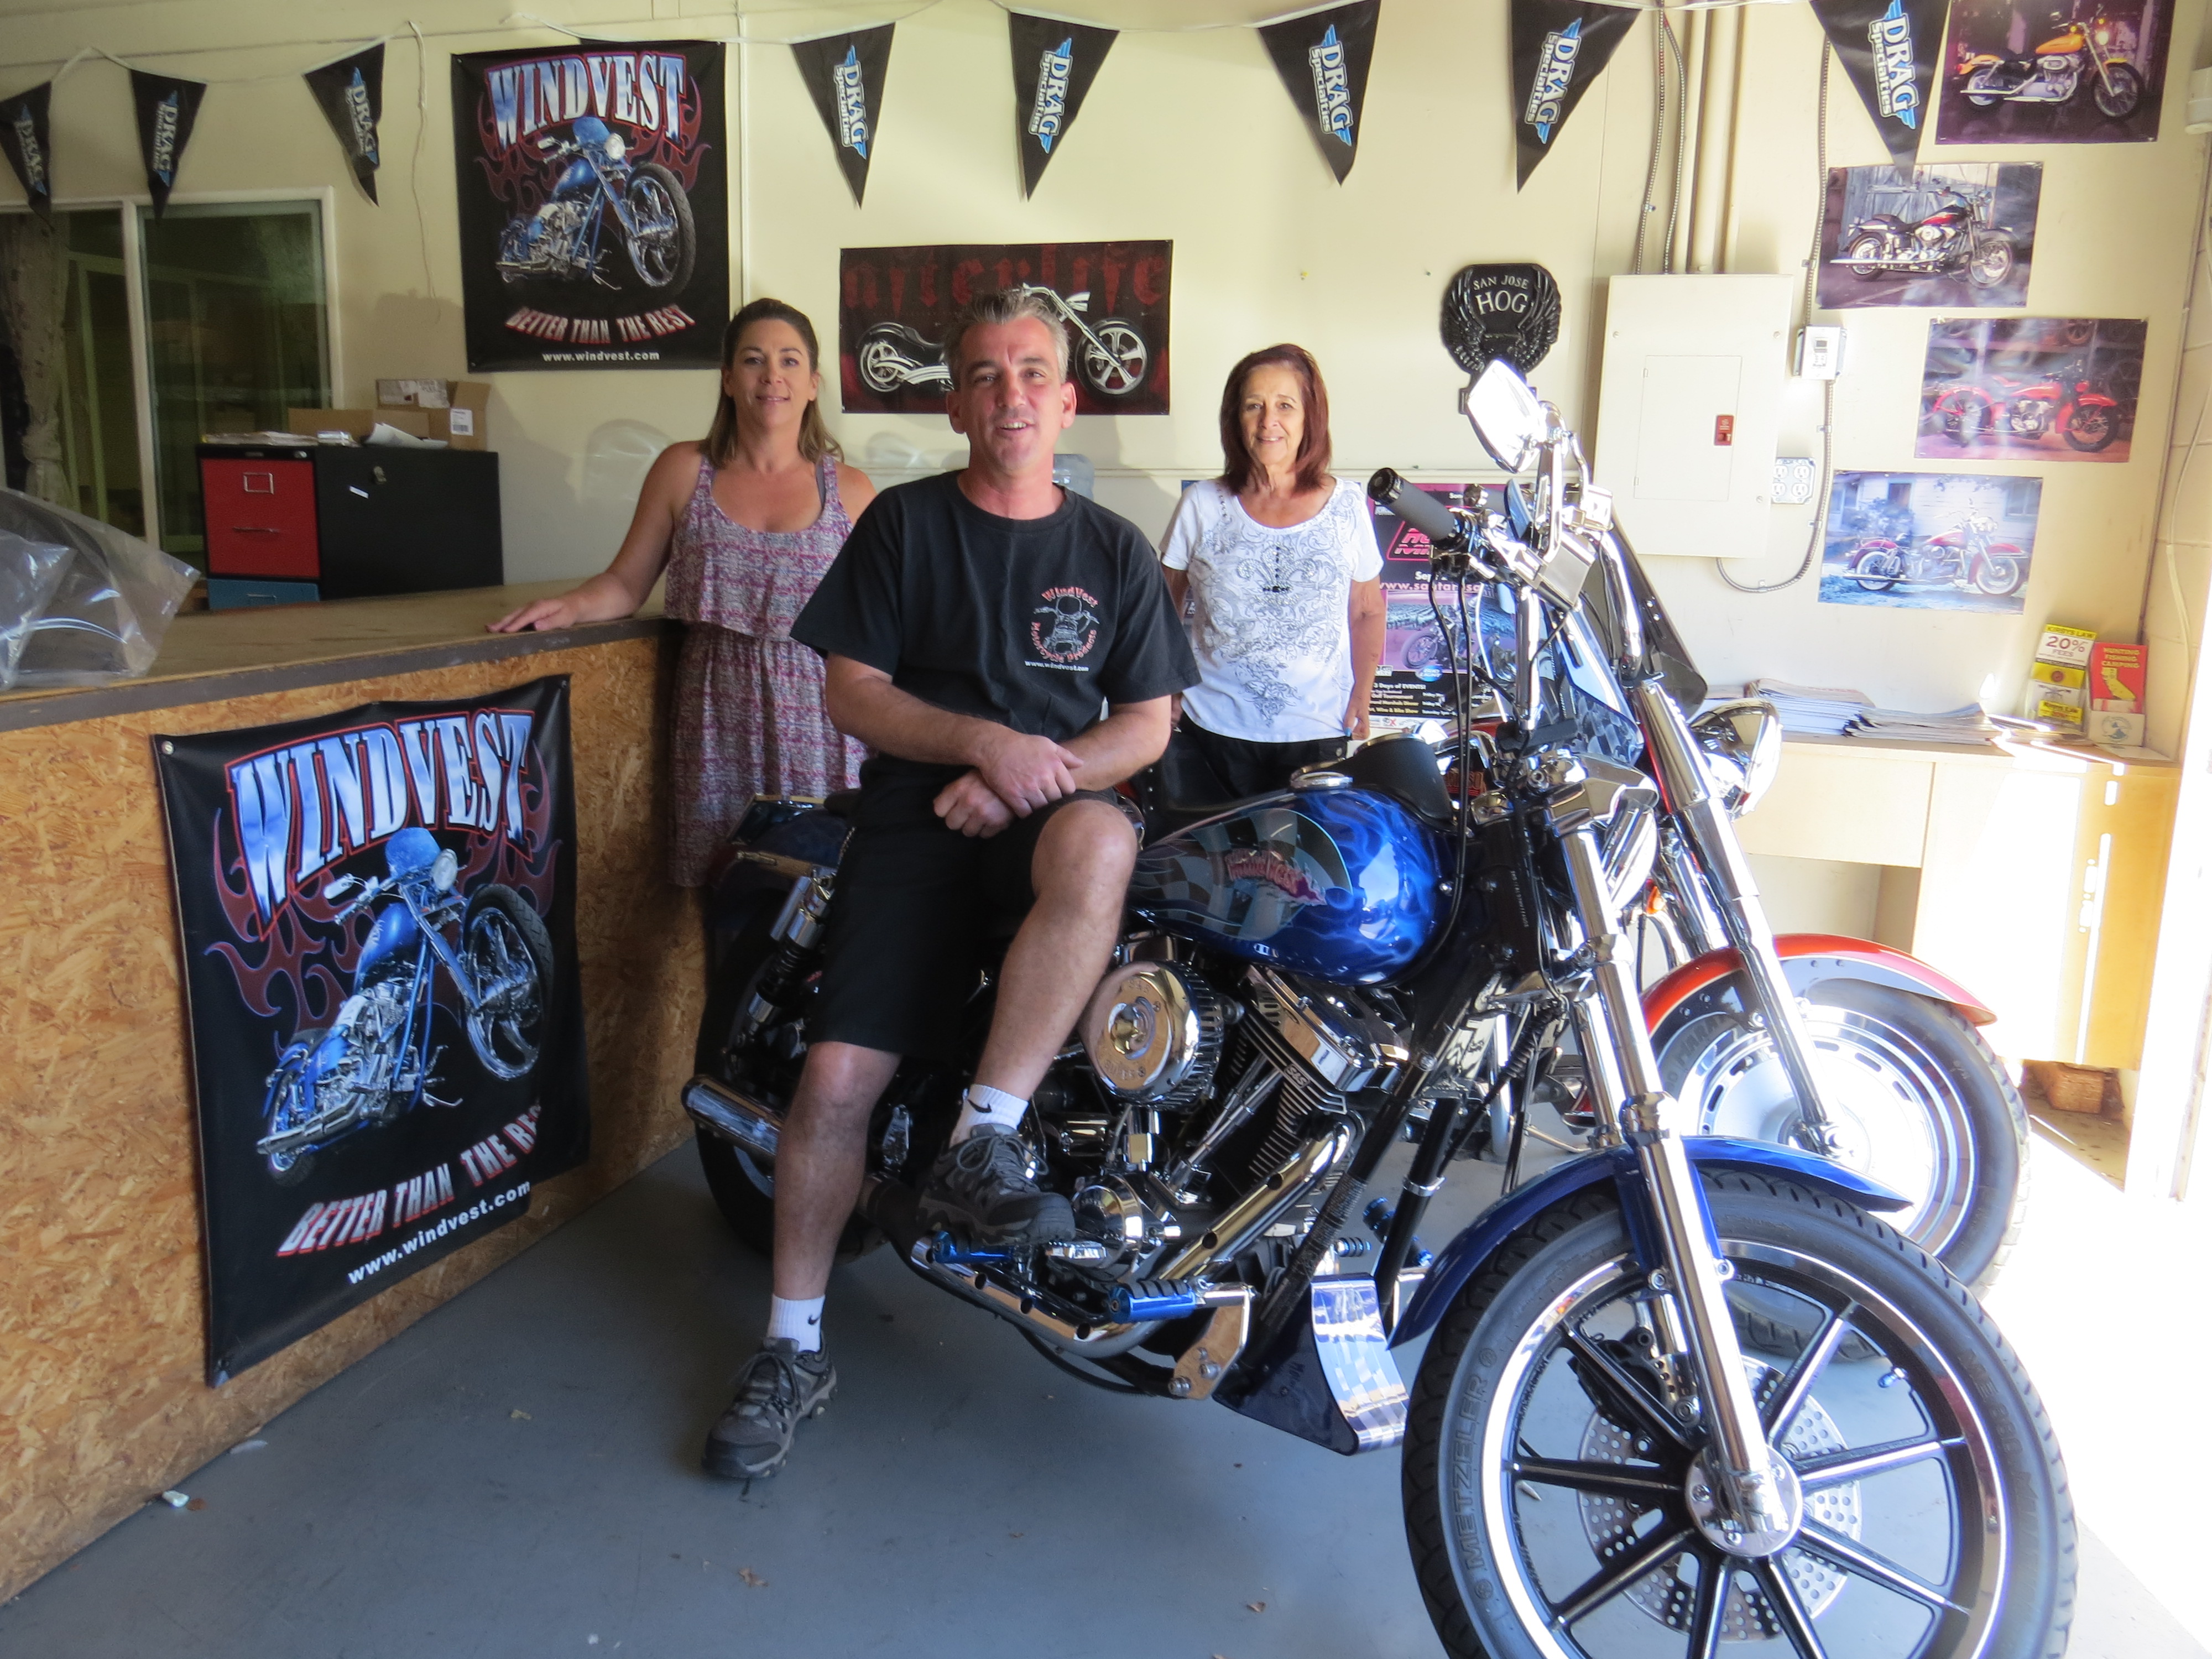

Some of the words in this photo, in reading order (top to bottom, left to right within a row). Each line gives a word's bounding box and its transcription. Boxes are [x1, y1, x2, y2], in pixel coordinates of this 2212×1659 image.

[488, 55, 687, 152] WINDVEST
[843, 64, 866, 144] DRAG
[1030, 52, 1053, 133] Specialties
[1038, 55, 1071, 136] DRAG
[1311, 48, 1332, 132] Specialties
[1321, 44, 1352, 132] DRAG
[1527, 34, 1558, 122] Specialties
[1535, 38, 1579, 124] DRAG
[1871, 22, 1892, 114] Specialties
[1883, 17, 1916, 112] DRAG
[159, 103, 178, 170] DRAG
[352, 85, 377, 153] DRAG
[836, 66, 851, 145] Specialties
[1473, 276, 1496, 290] SAN
[1501, 275, 1529, 290] JOSE
[1475, 290, 1528, 315] HOG
[505, 306, 568, 342] BETTER
[570, 319, 611, 344] THAN
[615, 315, 650, 343] THE
[645, 304, 696, 337] REST
[542, 350, 660, 362] www.windvest.com
[1025, 660, 1089, 671] www.windvest.com
[2046, 635, 2089, 652] 20%
[231, 713, 533, 922] WINDVEST
[1286, 1067, 1308, 1086] S&S
[277, 1190, 388, 1258] BETTER
[393, 1163, 455, 1228] THAN
[460, 1134, 518, 1187] THE
[348, 1181, 531, 1284] www.windvest.com
[1453, 1373, 1488, 1572] METZELER
